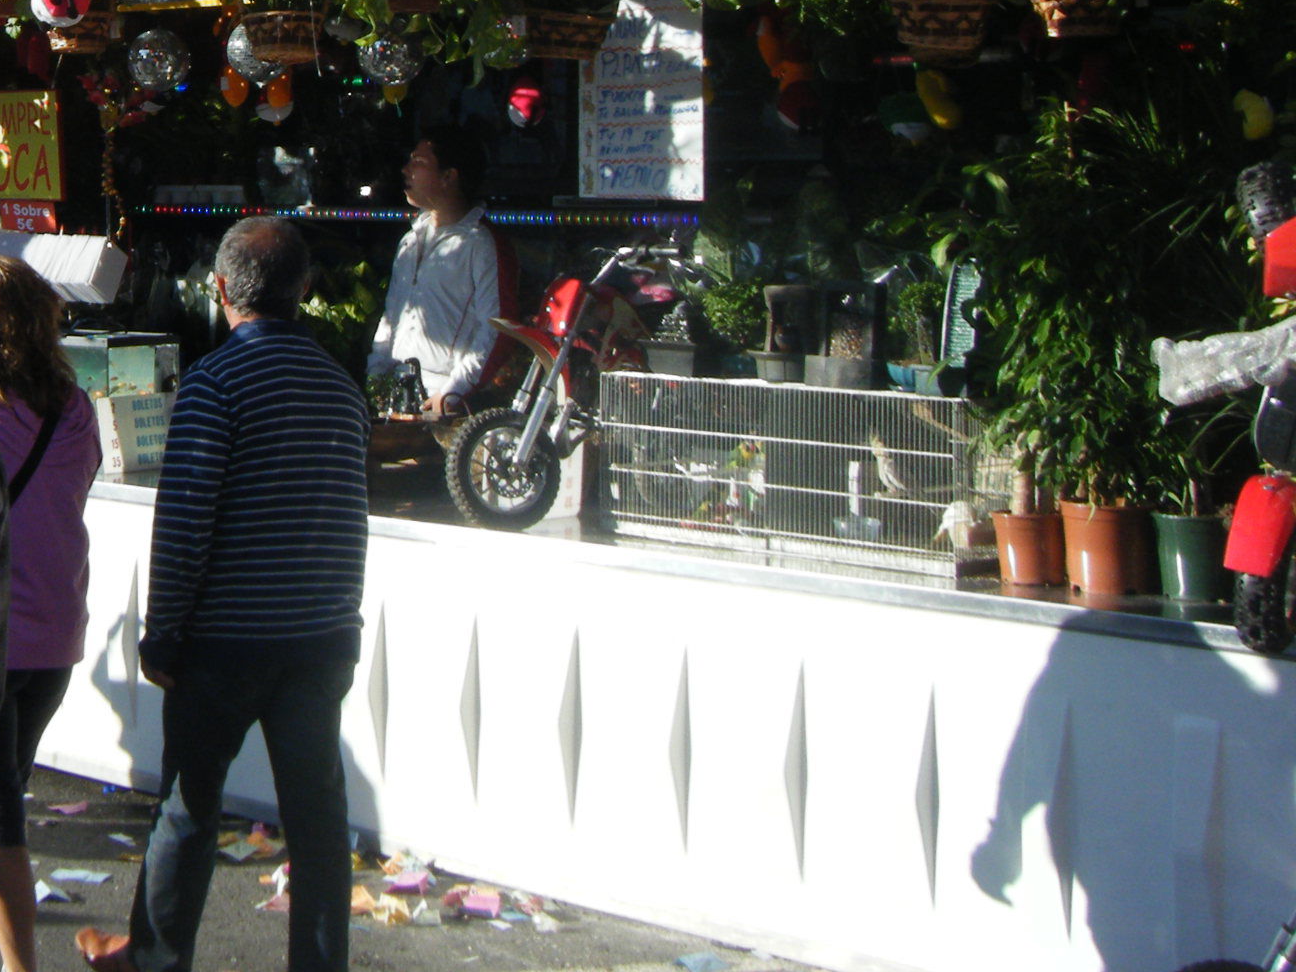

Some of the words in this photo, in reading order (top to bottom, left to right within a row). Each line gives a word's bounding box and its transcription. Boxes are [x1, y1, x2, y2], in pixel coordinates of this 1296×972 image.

[3, 203, 9, 215] 1
[12, 204, 51, 218] Sobre
[16, 218, 35, 231] 5€
[134, 415, 167, 429] BOLETOS
